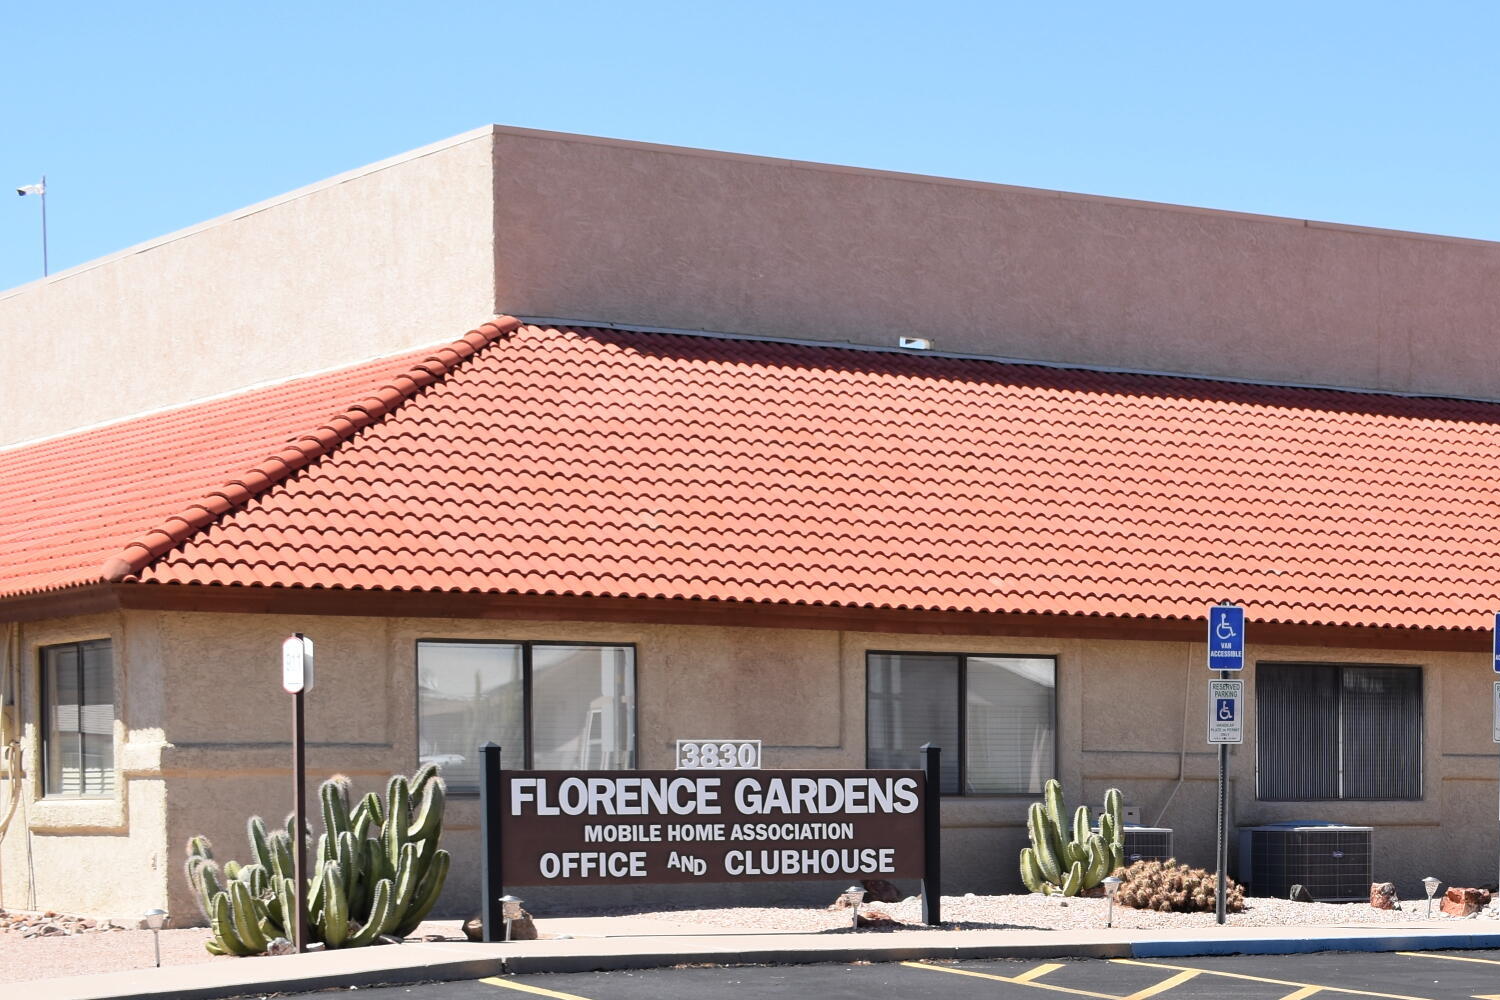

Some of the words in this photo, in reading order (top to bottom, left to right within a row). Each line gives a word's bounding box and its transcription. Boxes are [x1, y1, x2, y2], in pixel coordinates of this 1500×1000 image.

[681, 743, 757, 769] 3830
[511, 777, 721, 816] FLORENCE
[734, 777, 919, 815] GARDENS
[584, 824, 662, 843] MOBILE
[667, 823, 725, 842] HOME
[730, 822, 854, 841] ASSOCIATION
[539, 851, 648, 879] OFFICE
[667, 851, 707, 876] AND
[724, 848, 895, 875] CLUBHOUSE
